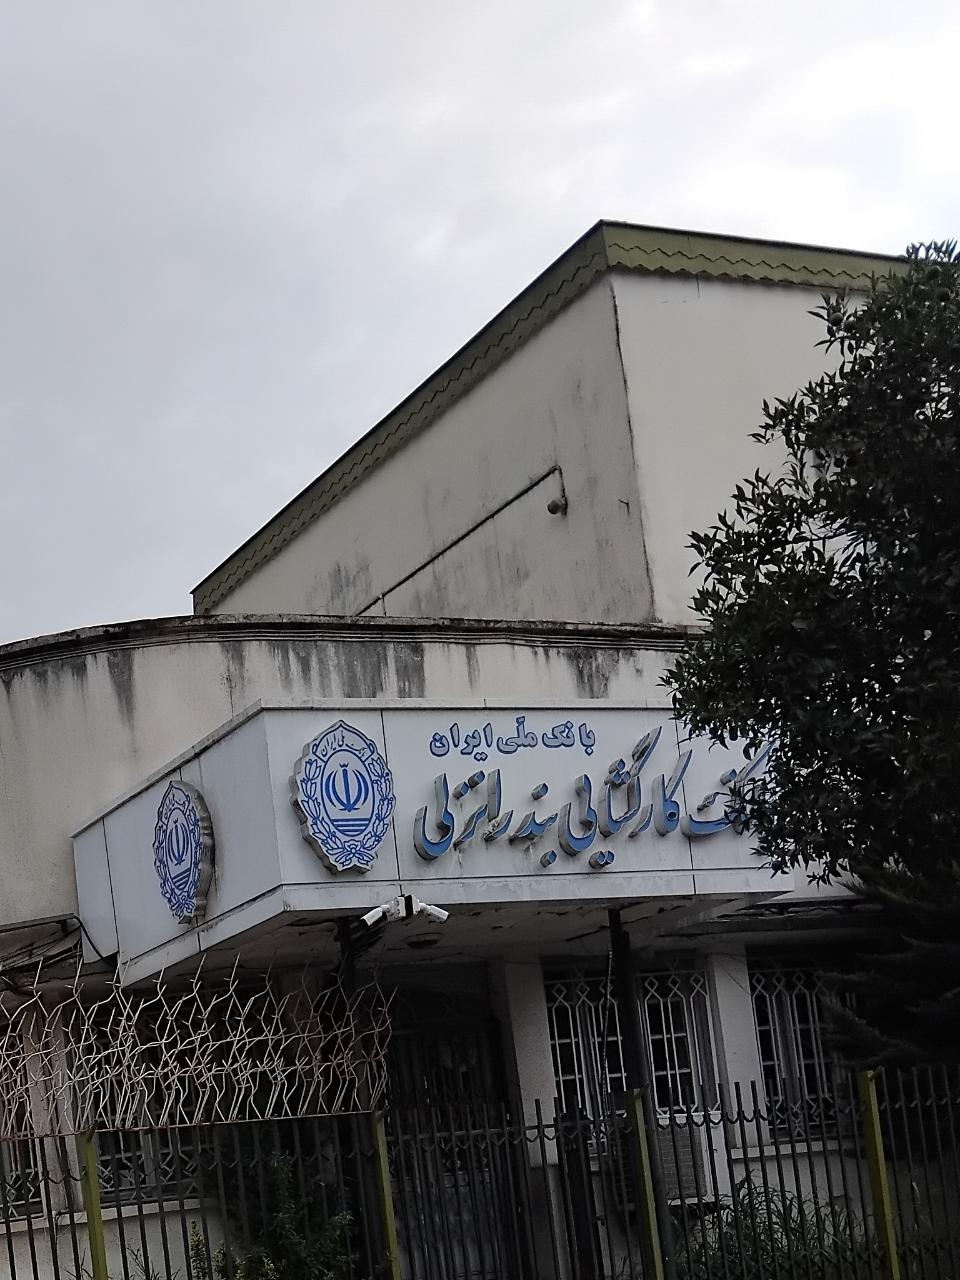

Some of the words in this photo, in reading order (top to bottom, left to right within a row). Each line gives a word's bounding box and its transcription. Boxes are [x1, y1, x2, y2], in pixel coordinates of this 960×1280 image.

[321, 733, 337, 757] ایران
[429, 722, 493, 761] ایران
[542, 721, 596, 756] بانک
